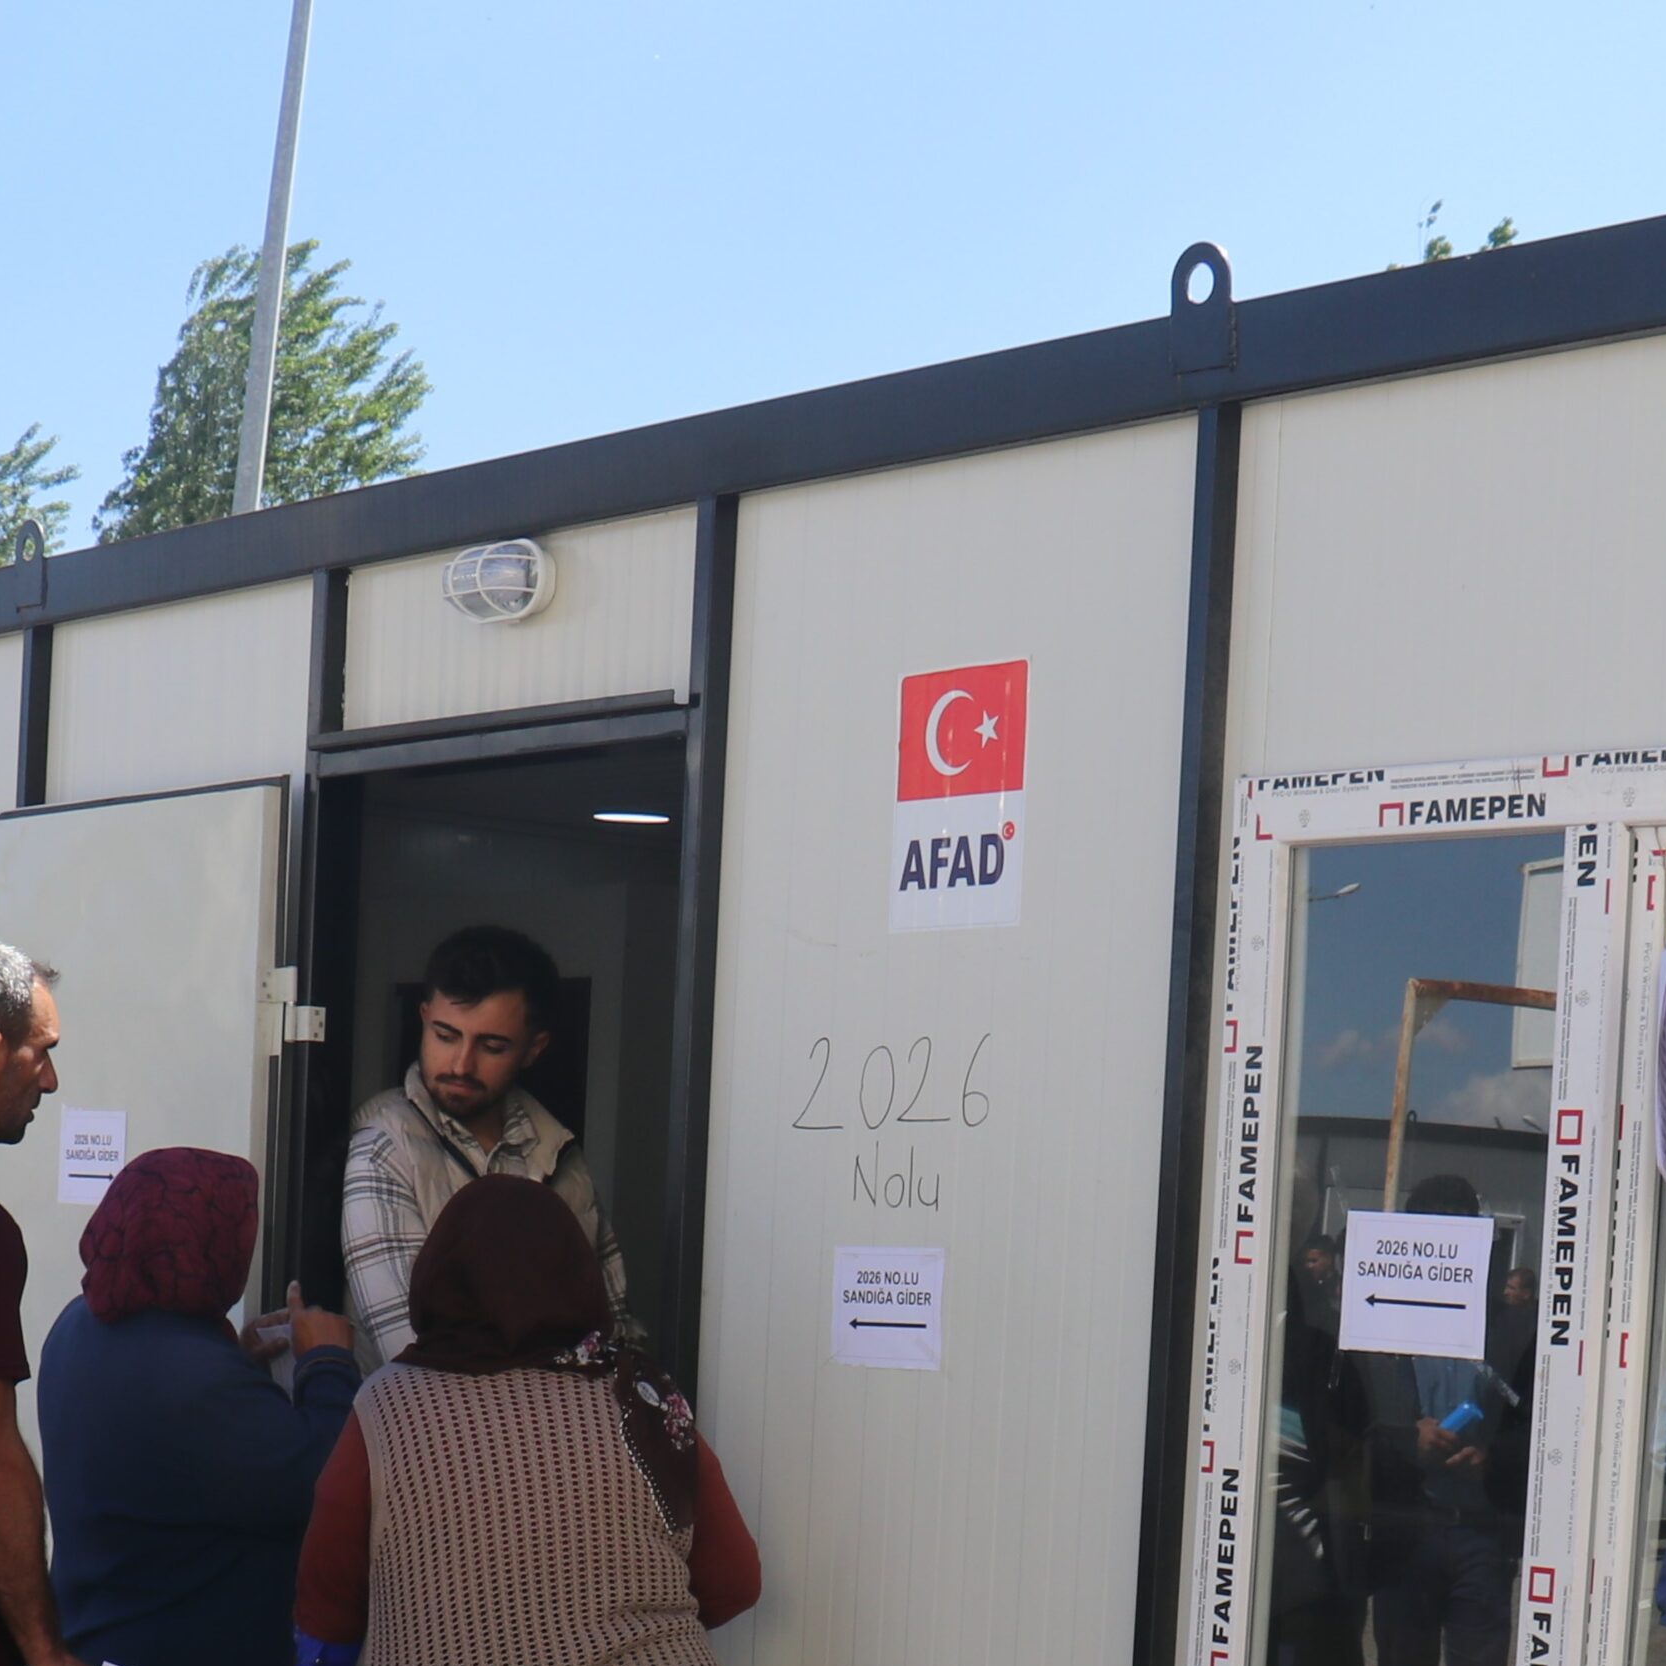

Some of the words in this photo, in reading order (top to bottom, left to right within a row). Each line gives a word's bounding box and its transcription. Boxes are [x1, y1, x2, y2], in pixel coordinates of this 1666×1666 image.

[1410, 793, 1546, 825] FAMEPEN
[899, 833, 1005, 892] AFAD
[1642, 942, 1651, 974] PVC-U
[1640, 975, 1649, 1013] Window
[792, 1033, 990, 1129] 2026
[1636, 1050, 1644, 1090] Systems
[1237, 1046, 1263, 1223] FAMEPEN
[853, 1140, 940, 1212] Nolu
[1552, 1176, 1560, 1207] PVC-U
[1550, 1209, 1558, 1247] Window
[1376, 1240, 1408, 1256] 2026
[1412, 1242, 1458, 1259] NO.LU
[1550, 1154, 1580, 1346] FAMEPEN
[857, 1271, 881, 1284] 2026
[884, 1272, 919, 1285] NO.LU
[1357, 1261, 1423, 1280] SANDIĞA
[1428, 1263, 1473, 1283] GİDER
[843, 1288, 893, 1304] SANDIĞA
[896, 1289, 932, 1305] GİDER
[1545, 1284, 1553, 1324] Systems
[1615, 1399, 1623, 1430] PVC-U
[1612, 1432, 1621, 1469] Window
[1607, 1506, 1615, 1545] Systems
[1212, 1468, 1239, 1644] FAMEPEN
[1523, 1632, 1531, 1663] PVC-U
